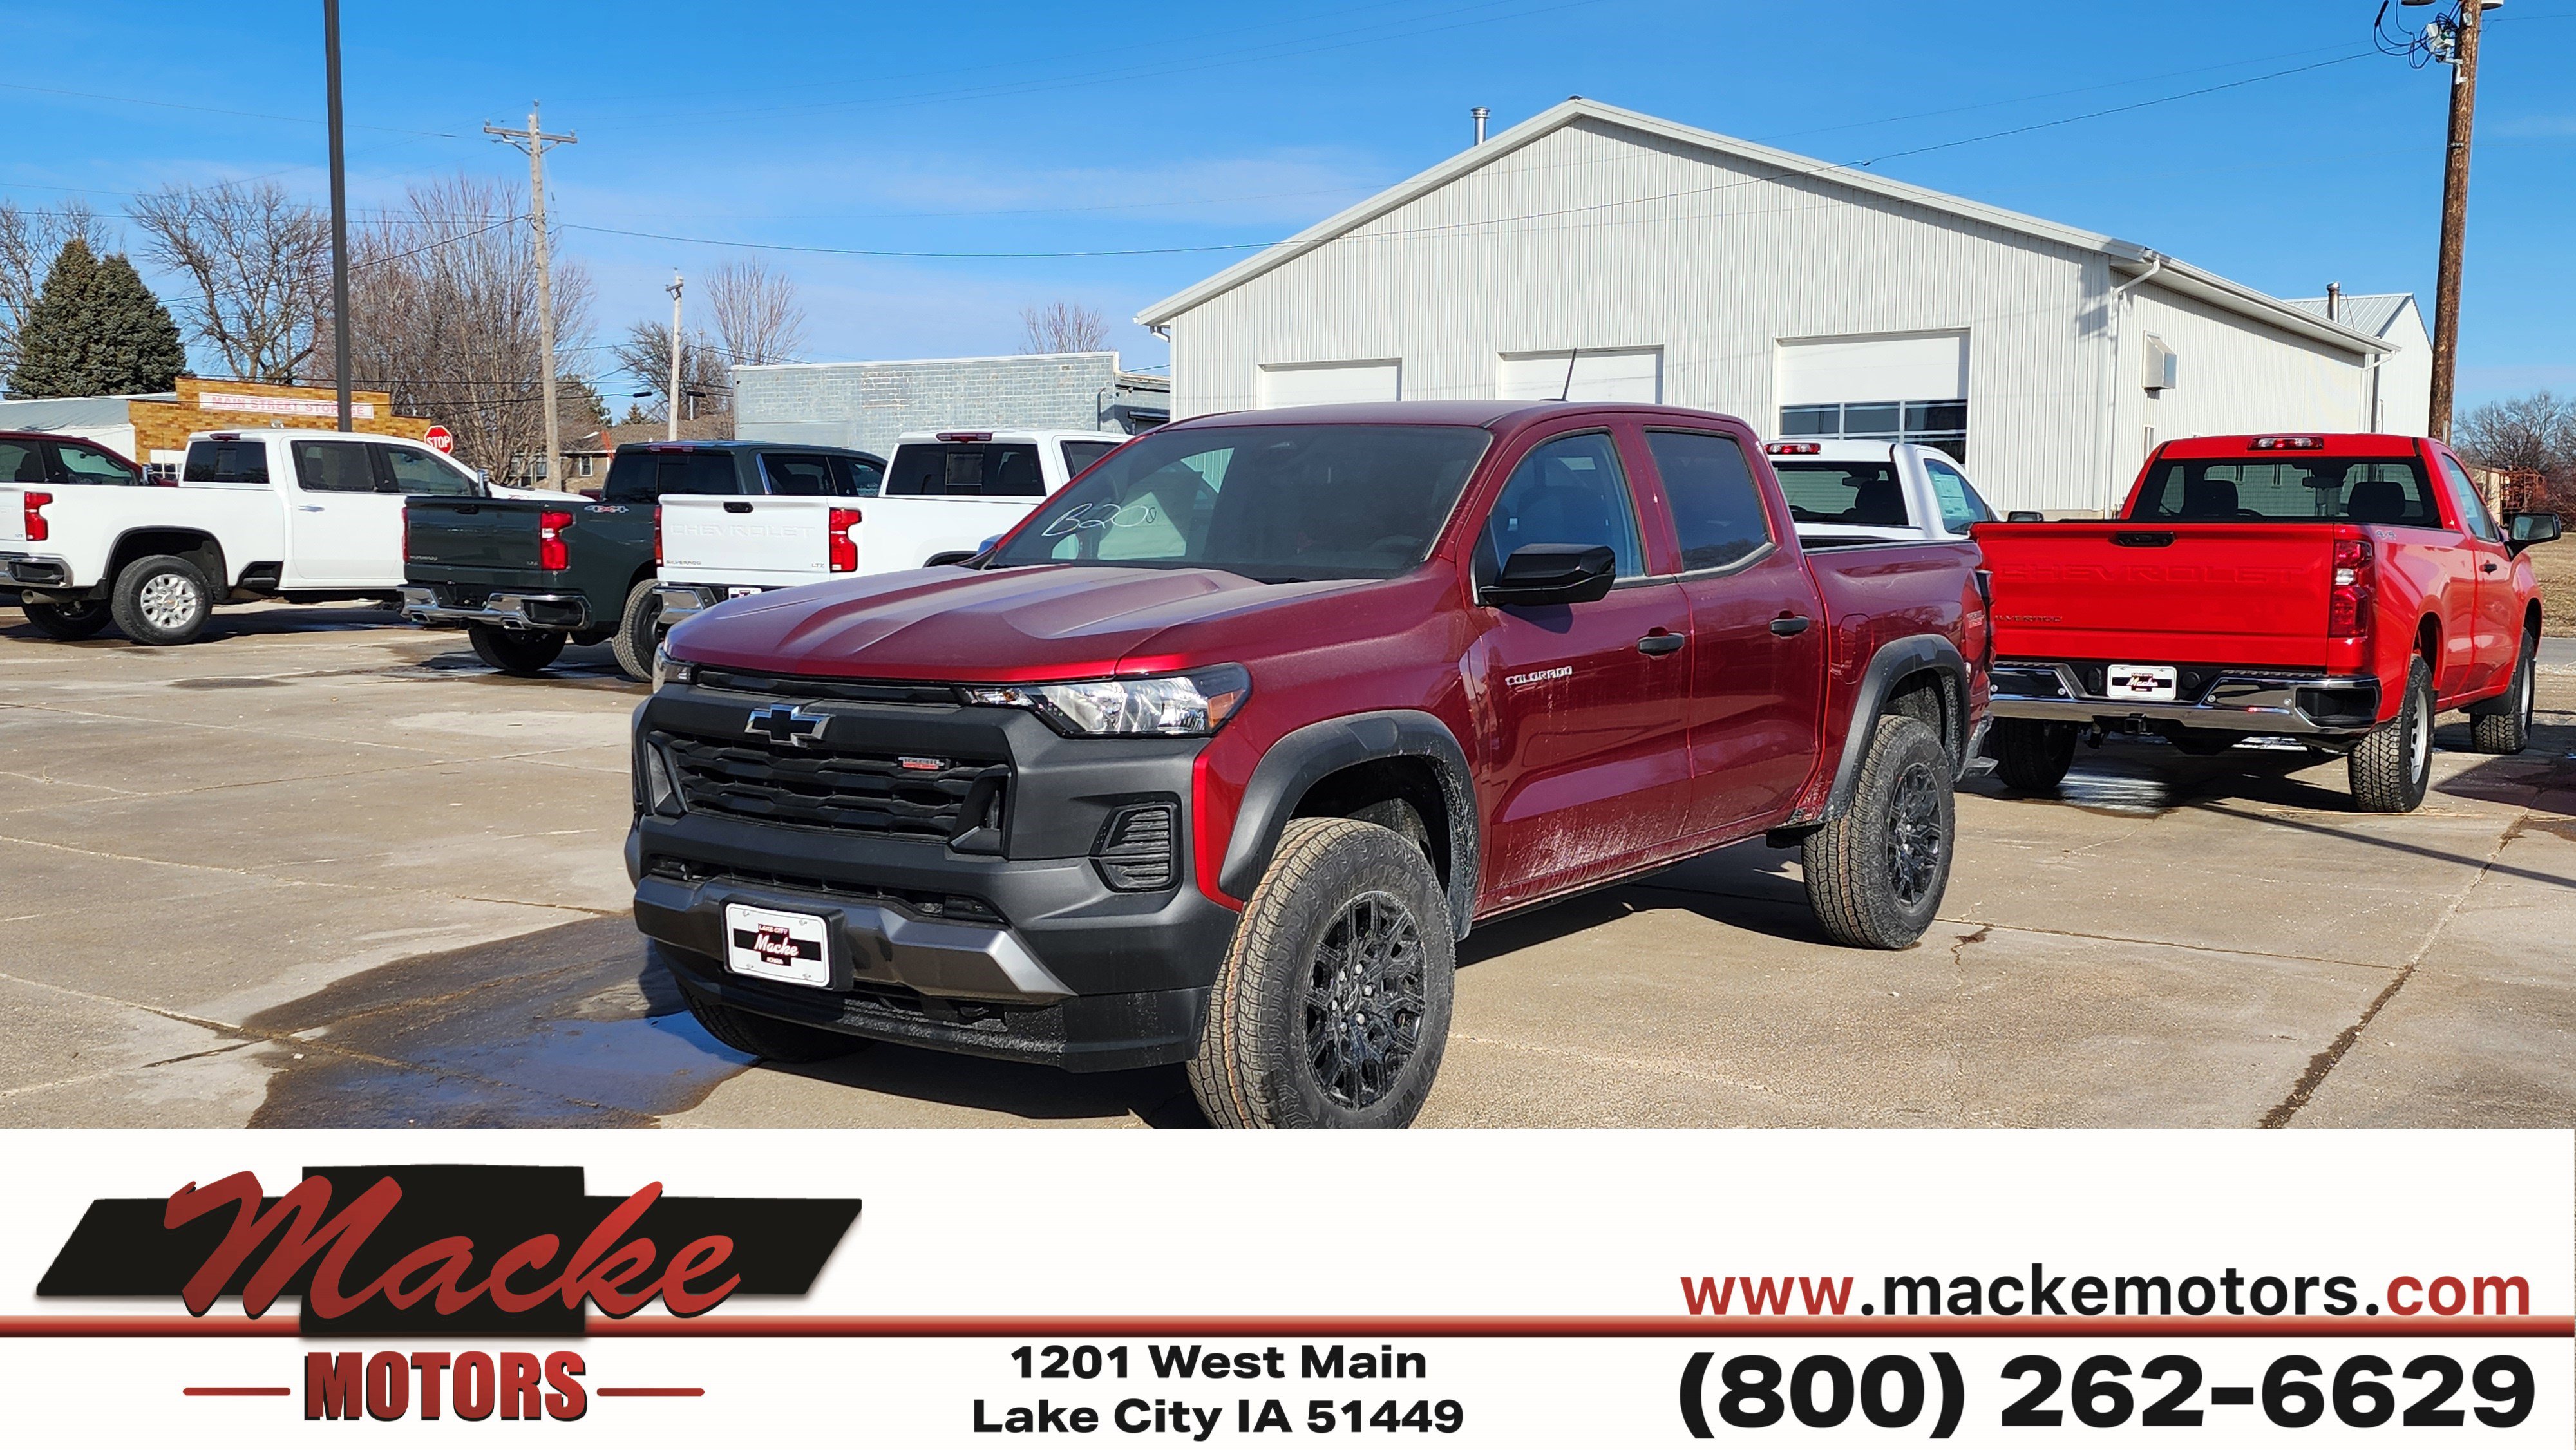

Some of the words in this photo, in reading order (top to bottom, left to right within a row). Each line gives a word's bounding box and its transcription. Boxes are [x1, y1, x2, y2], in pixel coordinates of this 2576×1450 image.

[212, 397, 245, 408] MAIN
[251, 399, 298, 411] STREET
[305, 404, 364, 415] STORGE
[426, 435, 450, 449] STOP
[670, 523, 815, 538] CHEVROLET
[1998, 563, 2304, 583] CHEVROLET
[1505, 666, 1573, 686] COLORADO
[753, 933, 799, 957] Macke
